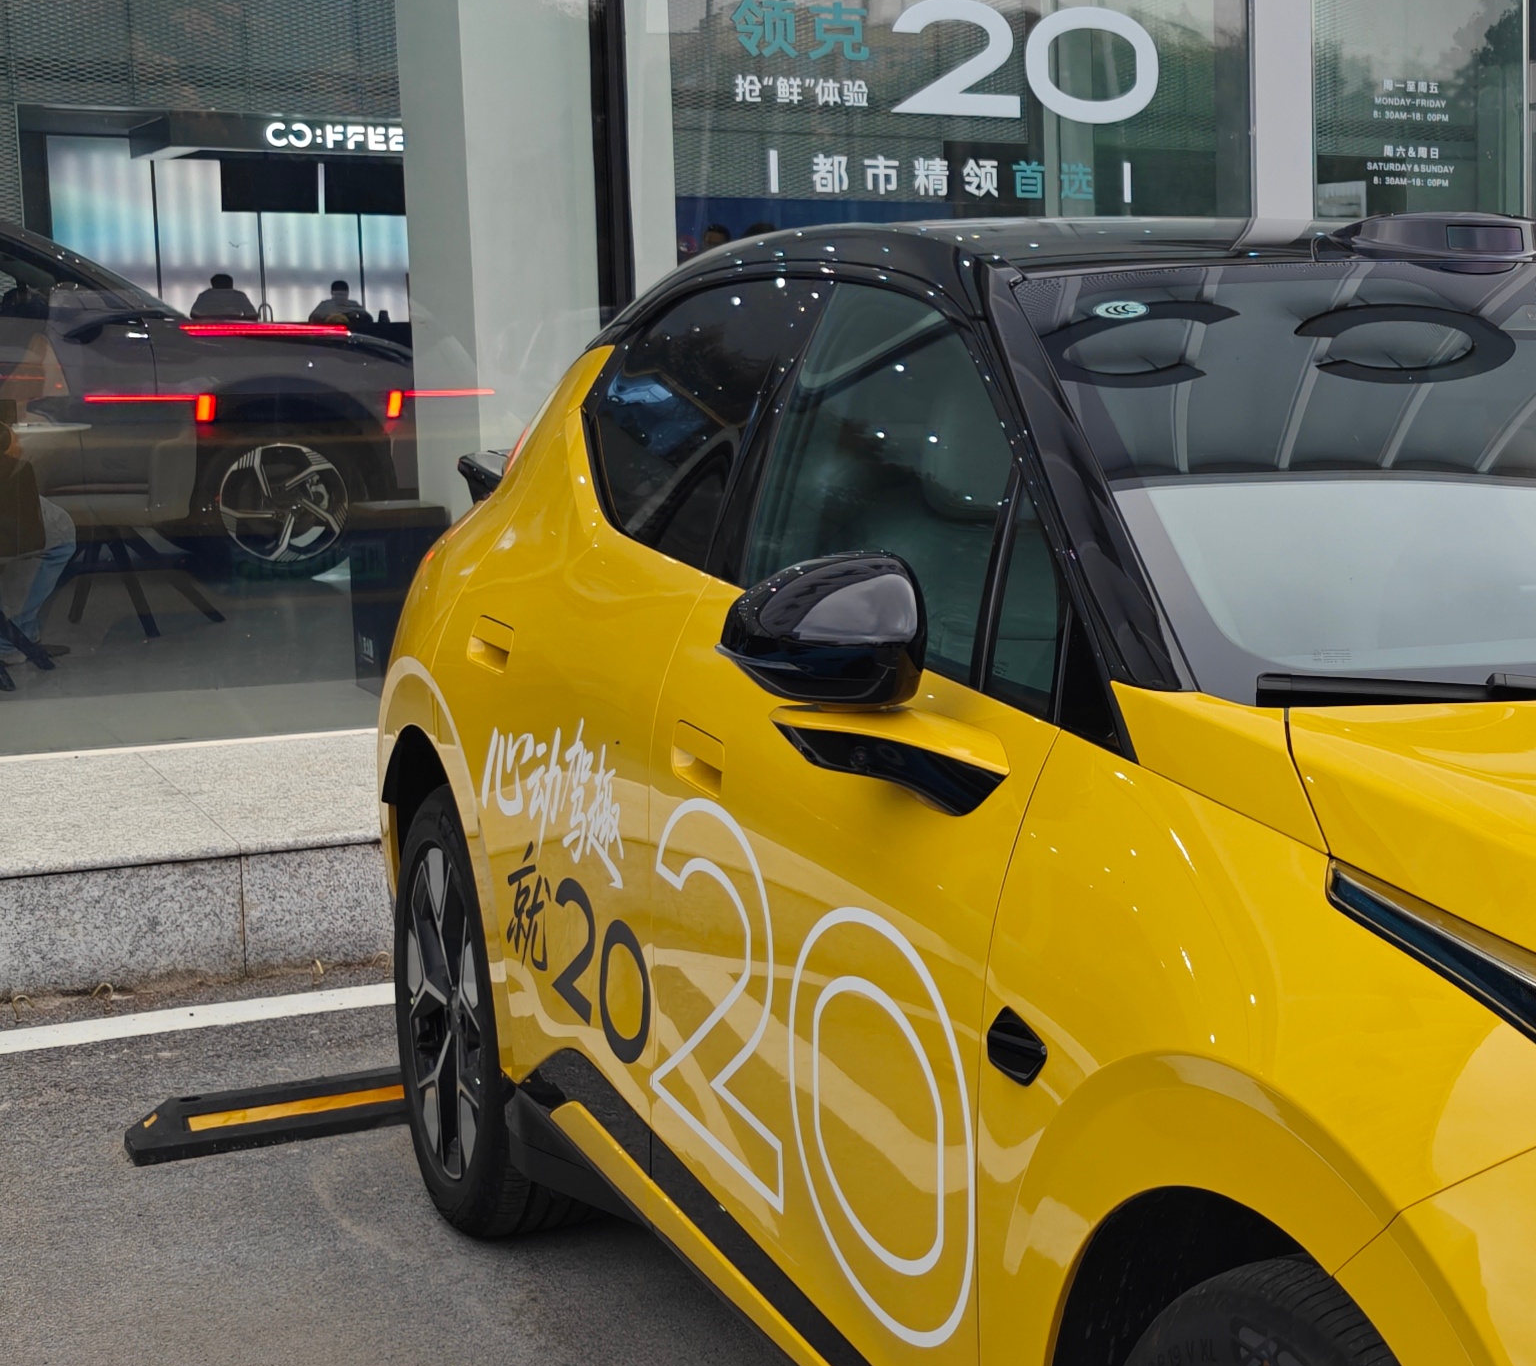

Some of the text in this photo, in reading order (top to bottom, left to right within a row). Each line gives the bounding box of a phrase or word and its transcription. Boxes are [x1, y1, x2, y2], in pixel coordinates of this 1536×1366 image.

[1382, 78, 1440, 94] 周一至周五
[1374, 96, 1447, 108] MONDAY-FRIDAY
[1383, 144, 1440, 159] 周六&周日
[811, 153, 1095, 201] 都市精领首选
[652, 797, 976, 1348] 20
